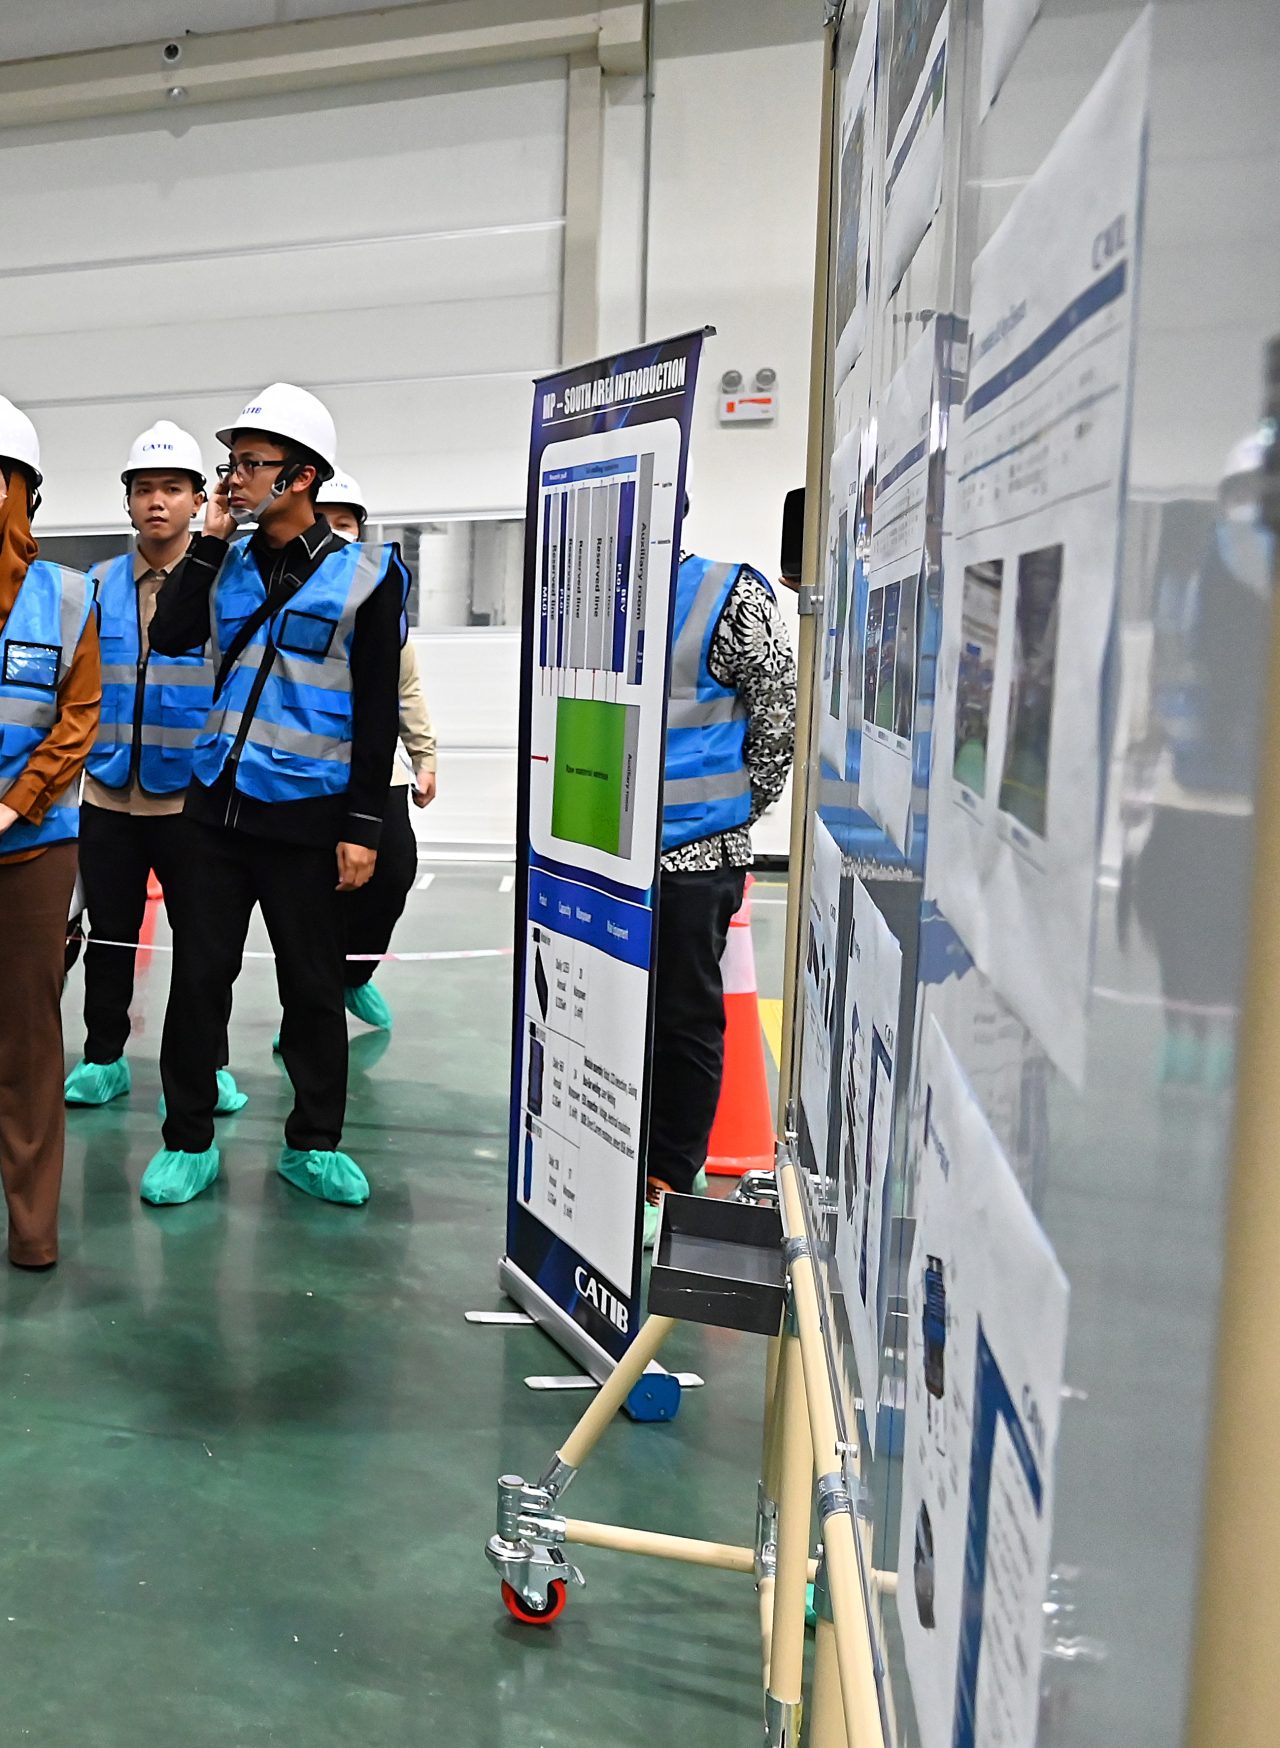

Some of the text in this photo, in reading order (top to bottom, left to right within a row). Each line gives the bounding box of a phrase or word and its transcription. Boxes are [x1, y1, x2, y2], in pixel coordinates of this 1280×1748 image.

[564, 382, 592, 415] SOUTH
[591, 376, 615, 407] AREA
[614, 357, 687, 401] INTRODUCTION
[593, 537, 603, 618] Reserved line
[634, 522, 647, 620] Auxiliary room
[574, 1266, 629, 1334] CATIB
